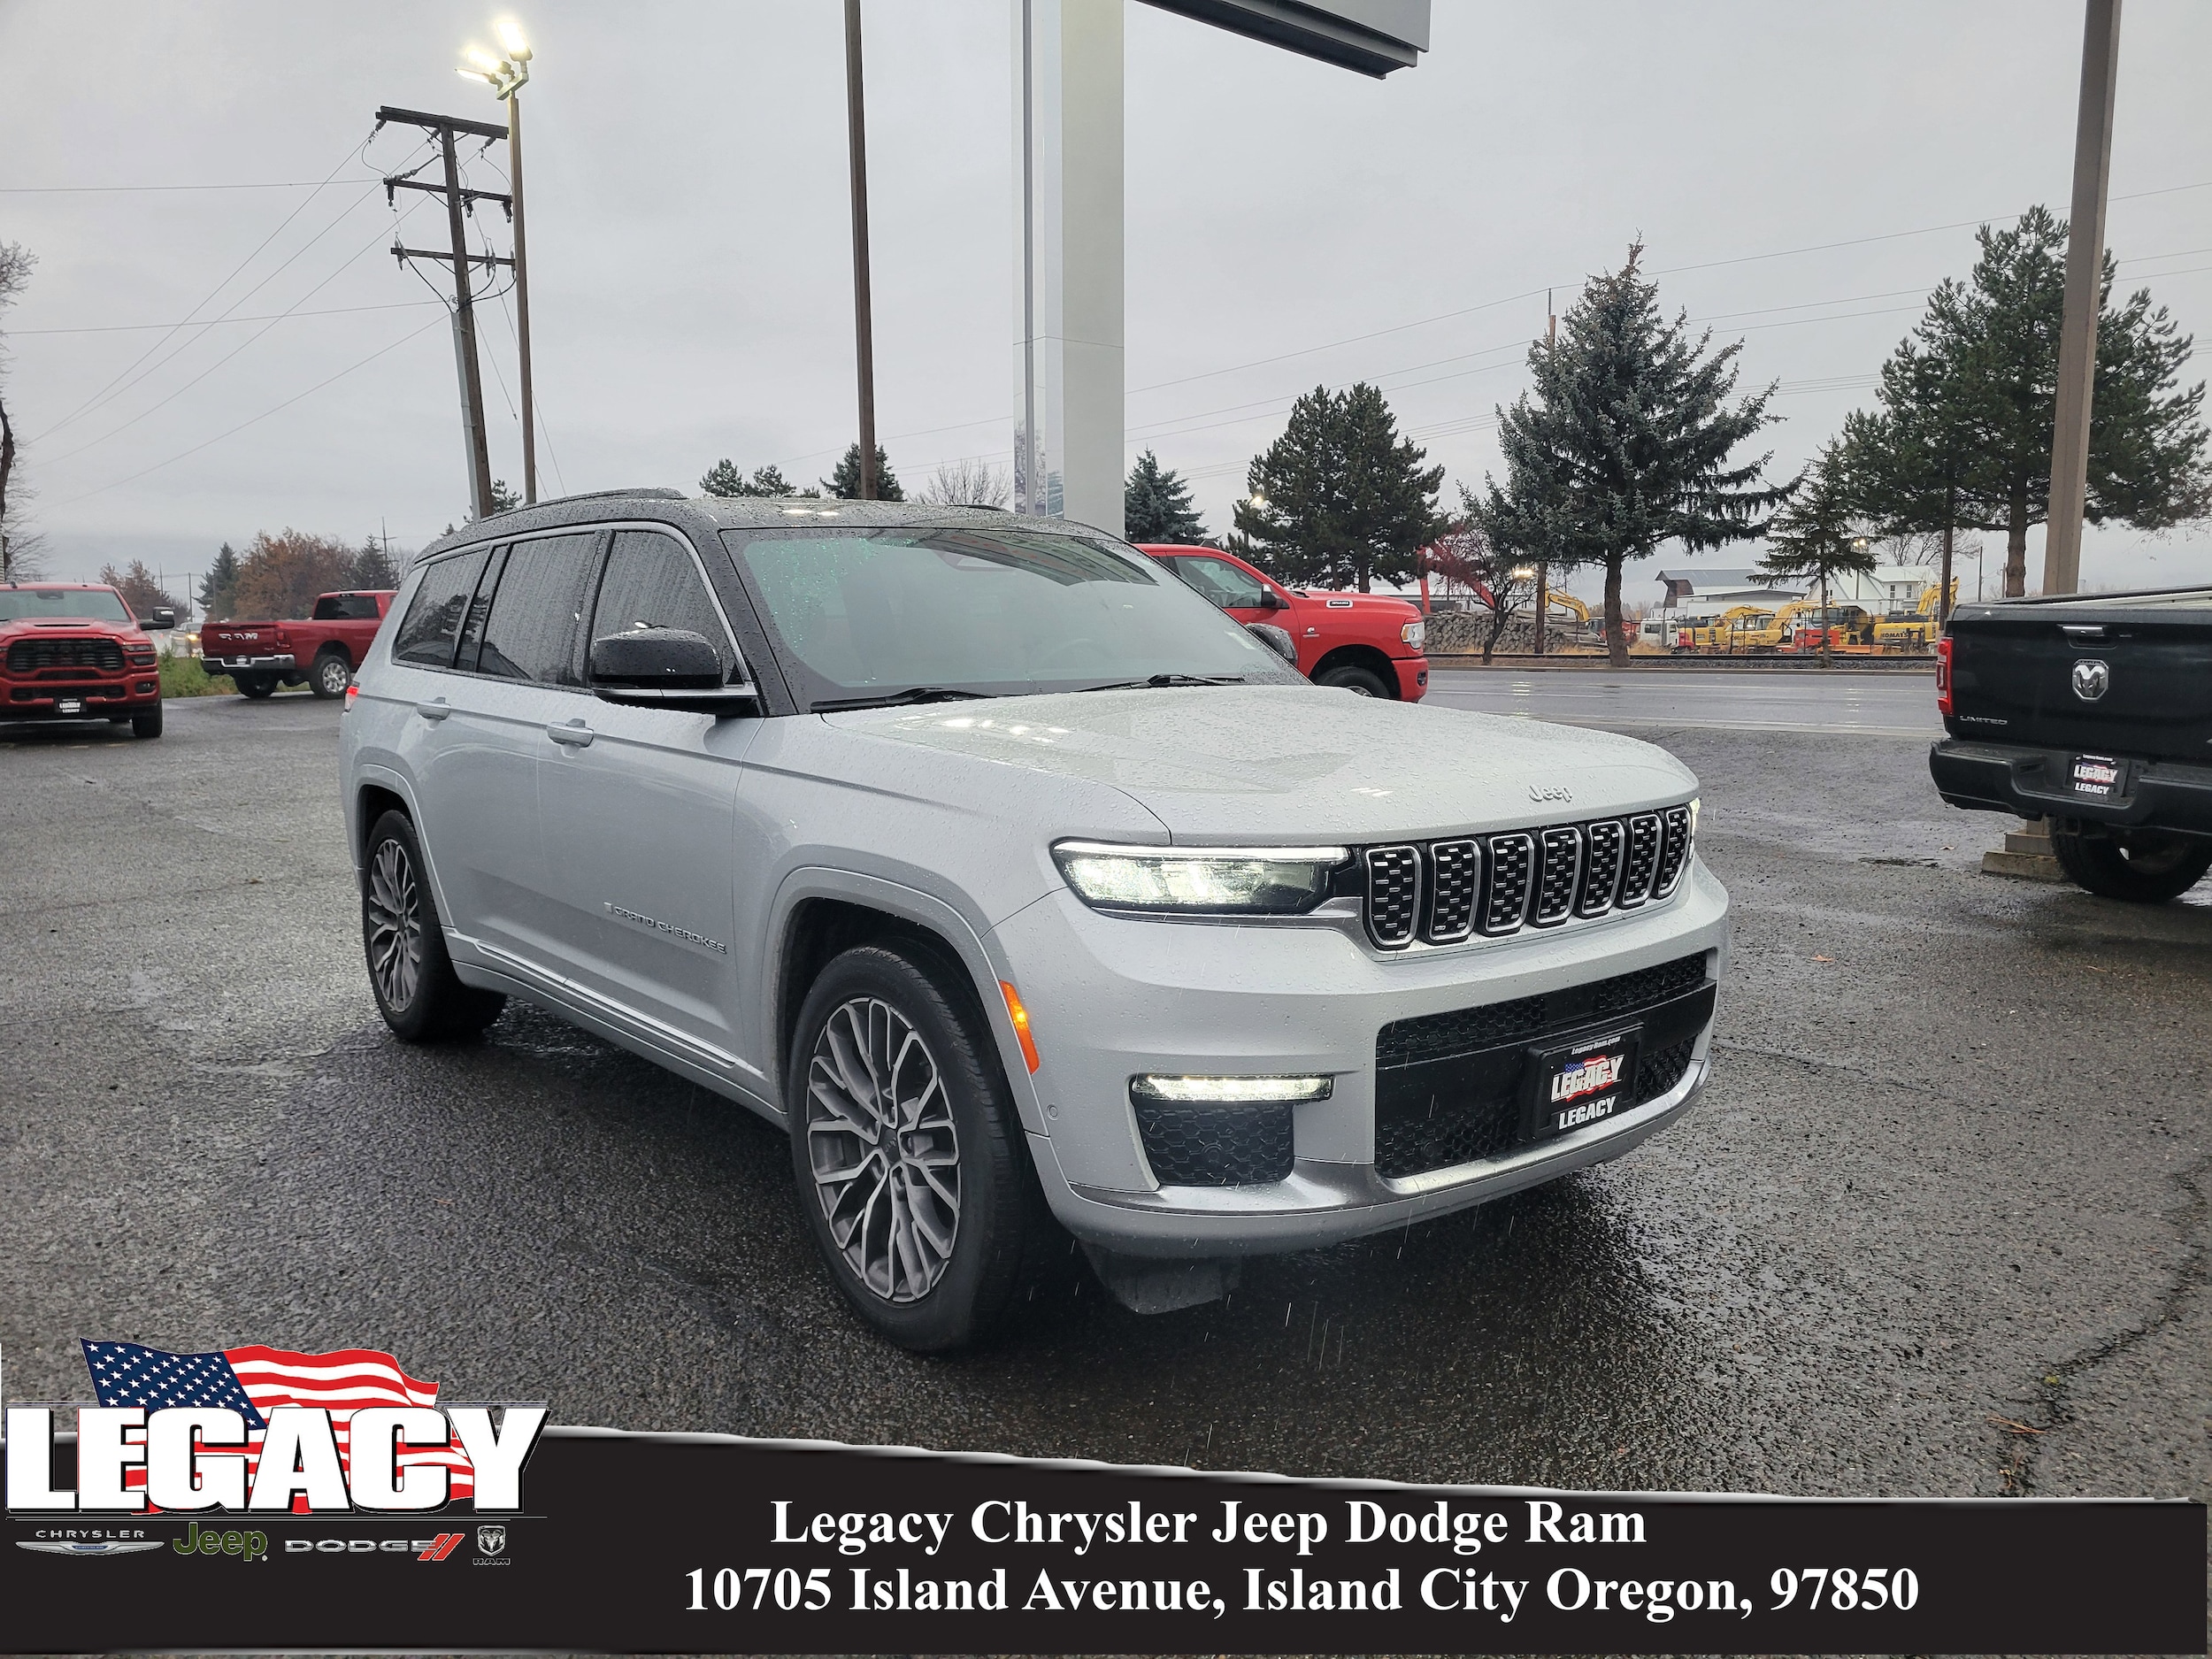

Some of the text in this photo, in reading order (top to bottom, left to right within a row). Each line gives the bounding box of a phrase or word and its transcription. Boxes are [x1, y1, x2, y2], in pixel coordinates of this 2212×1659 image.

[1960, 715, 2008, 725] LIMITED
[2074, 764, 2118, 782] LEGACY
[1529, 785, 1572, 803] Jeep
[2075, 782, 2109, 795] LEGACY
[614, 906, 727, 954] GRAND CHEROKEE
[1551, 1056, 1624, 1101] LEGACY
[1559, 1096, 1616, 1129] LEGACY
